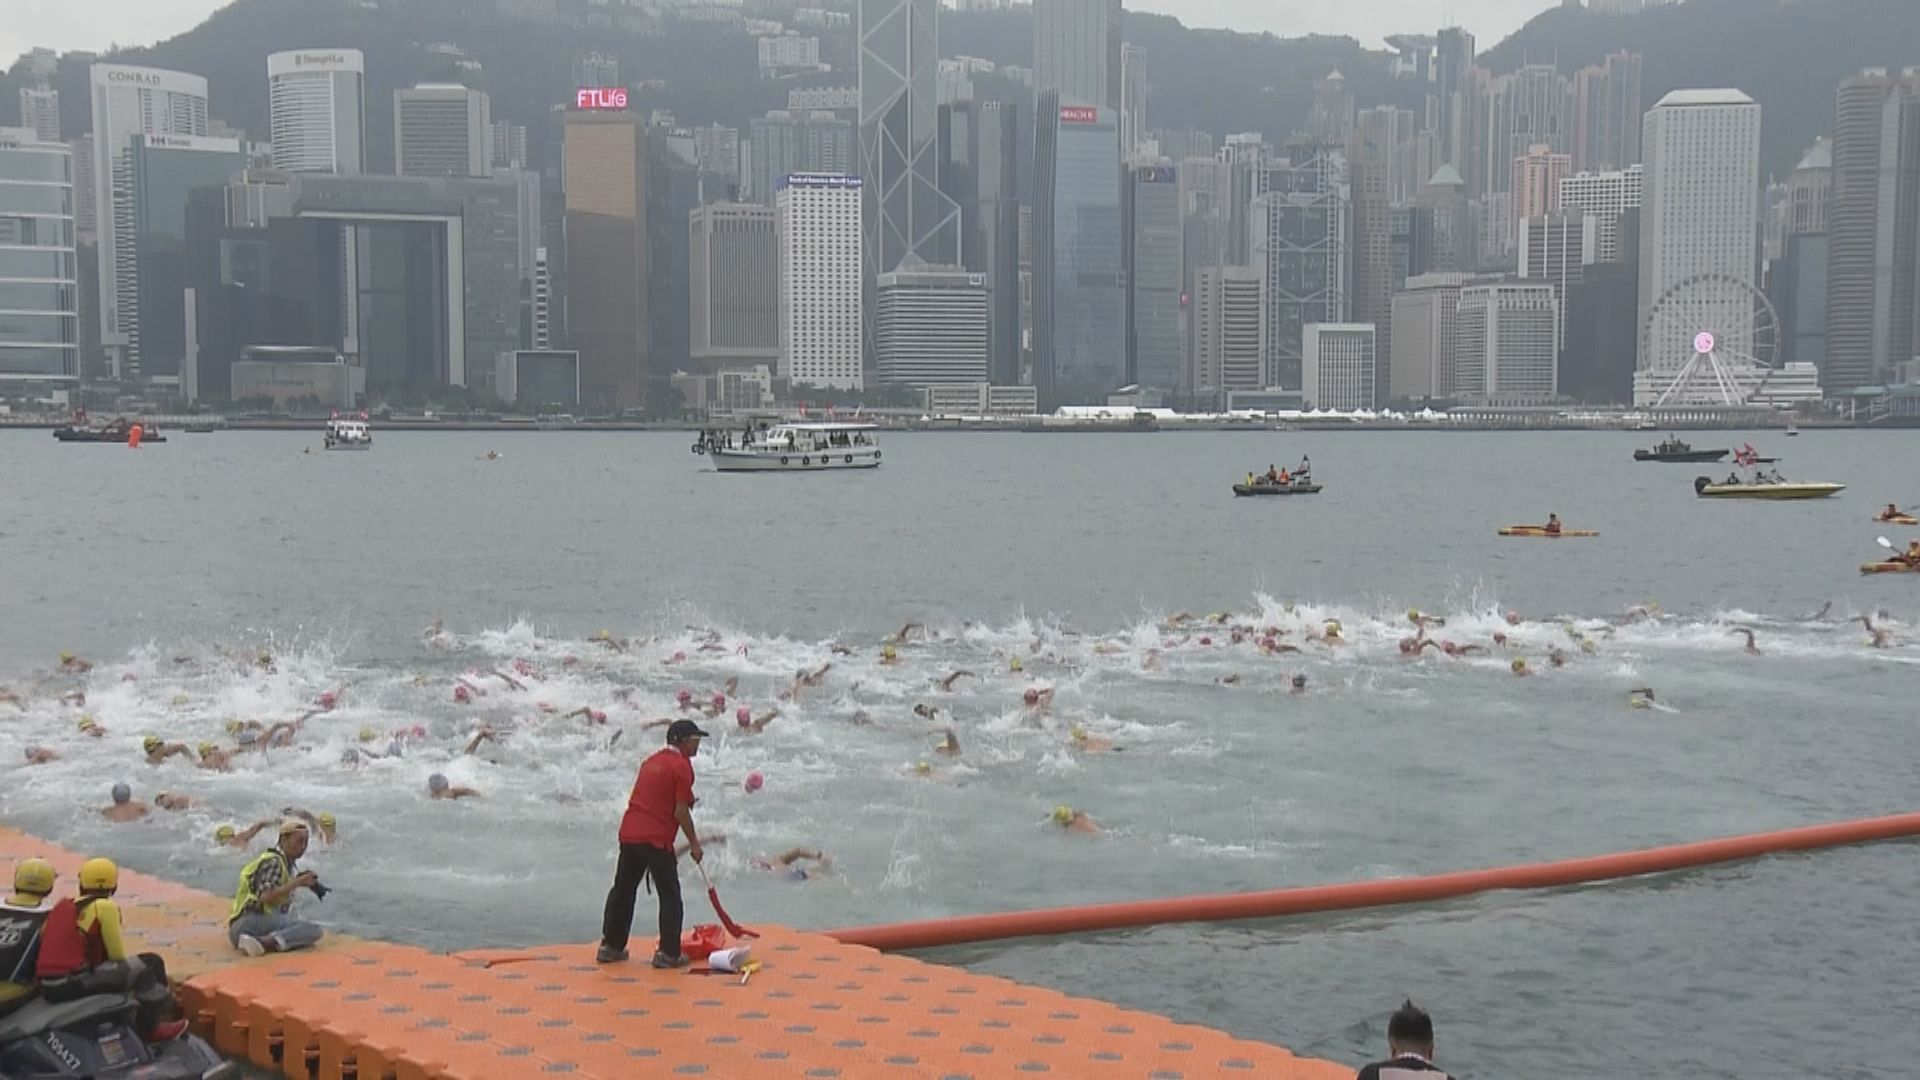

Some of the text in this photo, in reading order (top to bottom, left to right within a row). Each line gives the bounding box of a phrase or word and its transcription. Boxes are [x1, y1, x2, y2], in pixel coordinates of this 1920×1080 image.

[108, 70, 160, 85] CONRAD
[577, 89, 627, 108] FTLife
[47, 1031, 81, 1070] 705427
